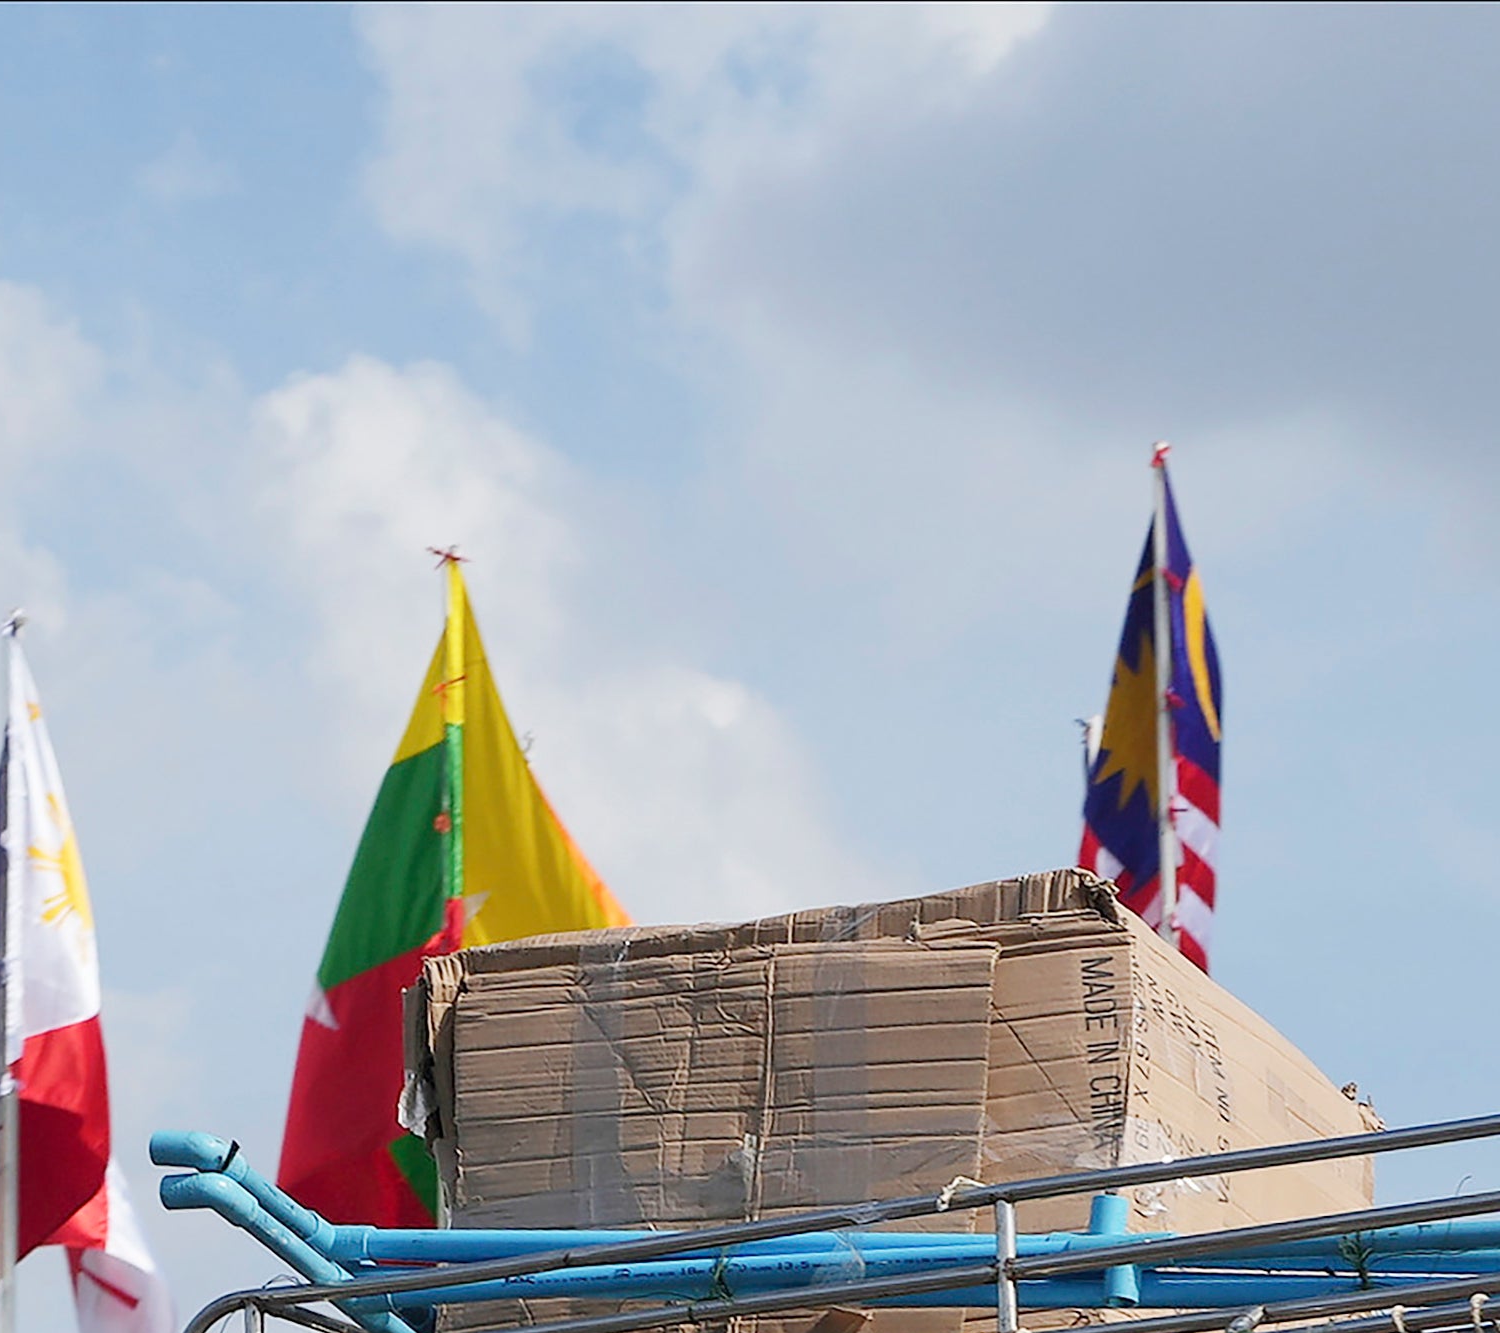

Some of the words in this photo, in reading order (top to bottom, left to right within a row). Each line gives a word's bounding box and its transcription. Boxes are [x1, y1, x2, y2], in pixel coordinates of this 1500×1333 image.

[1081, 956, 1118, 1031] MADE
[1086, 1041, 1120, 1065] IN
[1200, 1020, 1225, 1080] ITEM
[1089, 1075, 1124, 1149] CHINA
